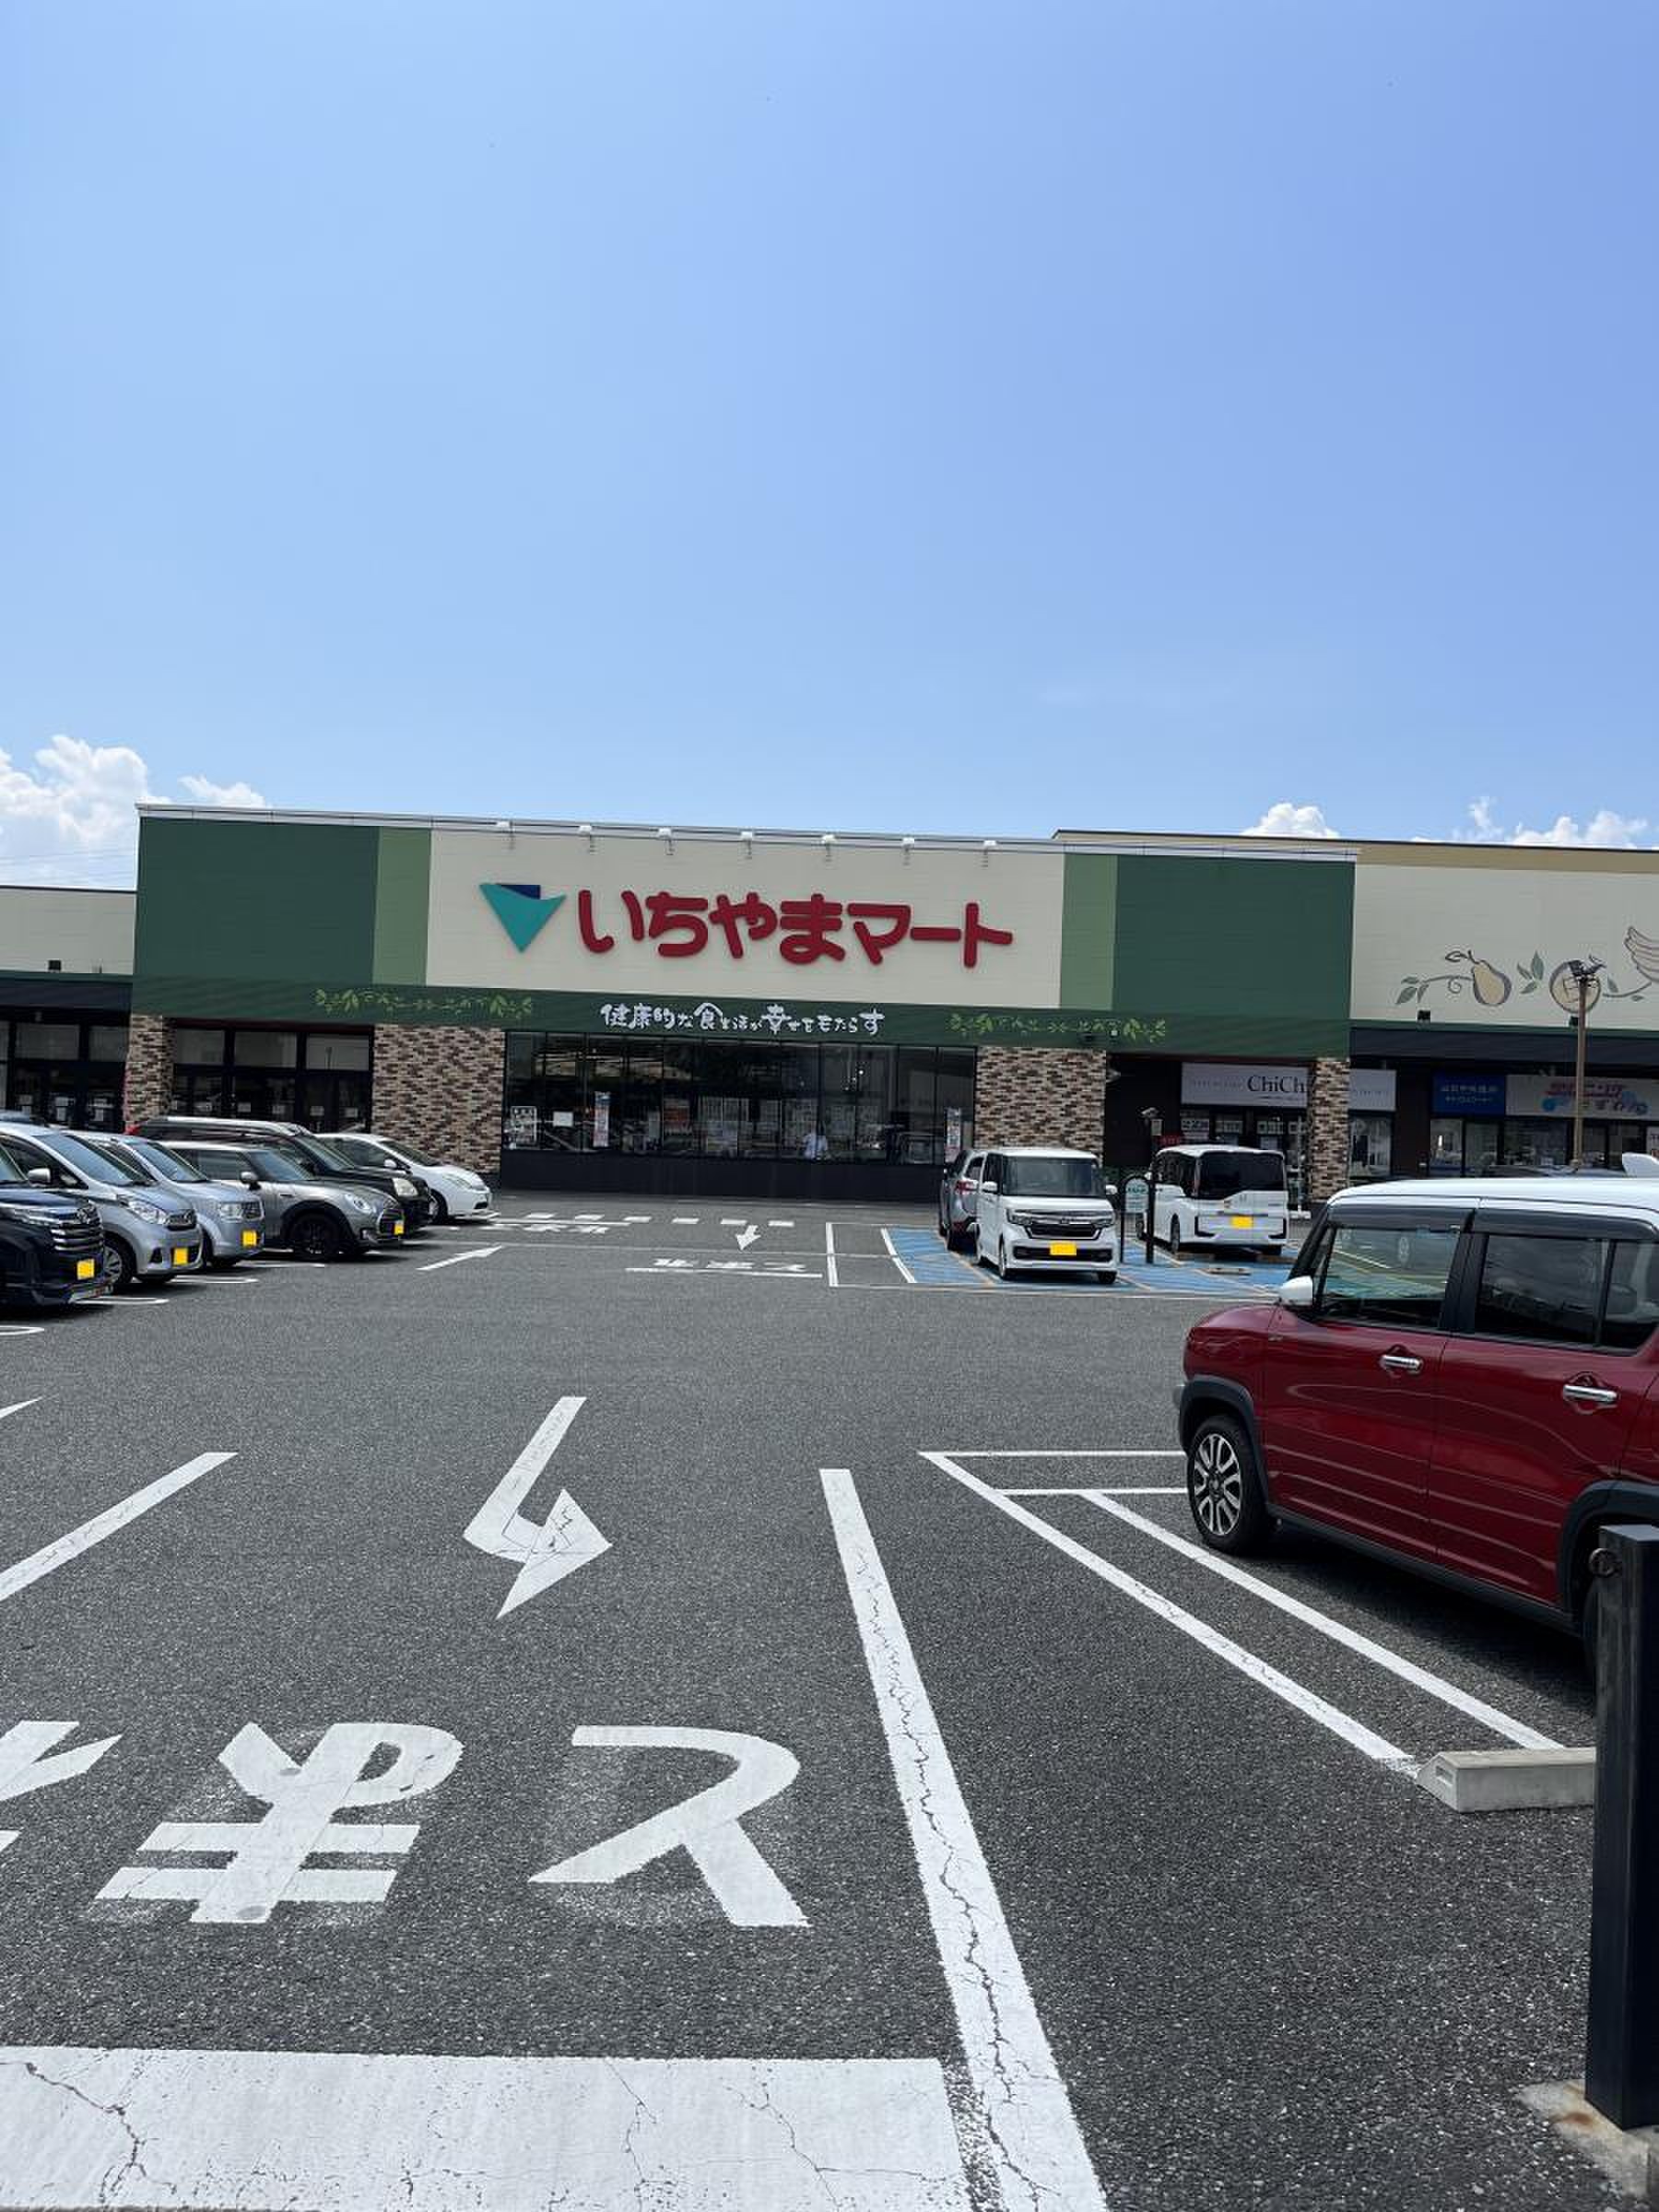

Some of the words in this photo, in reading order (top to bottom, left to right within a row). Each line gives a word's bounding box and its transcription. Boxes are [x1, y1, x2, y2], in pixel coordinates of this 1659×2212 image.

[578, 889, 1013, 969] いちやまマート
[0, 1720, 810, 1926] とま
